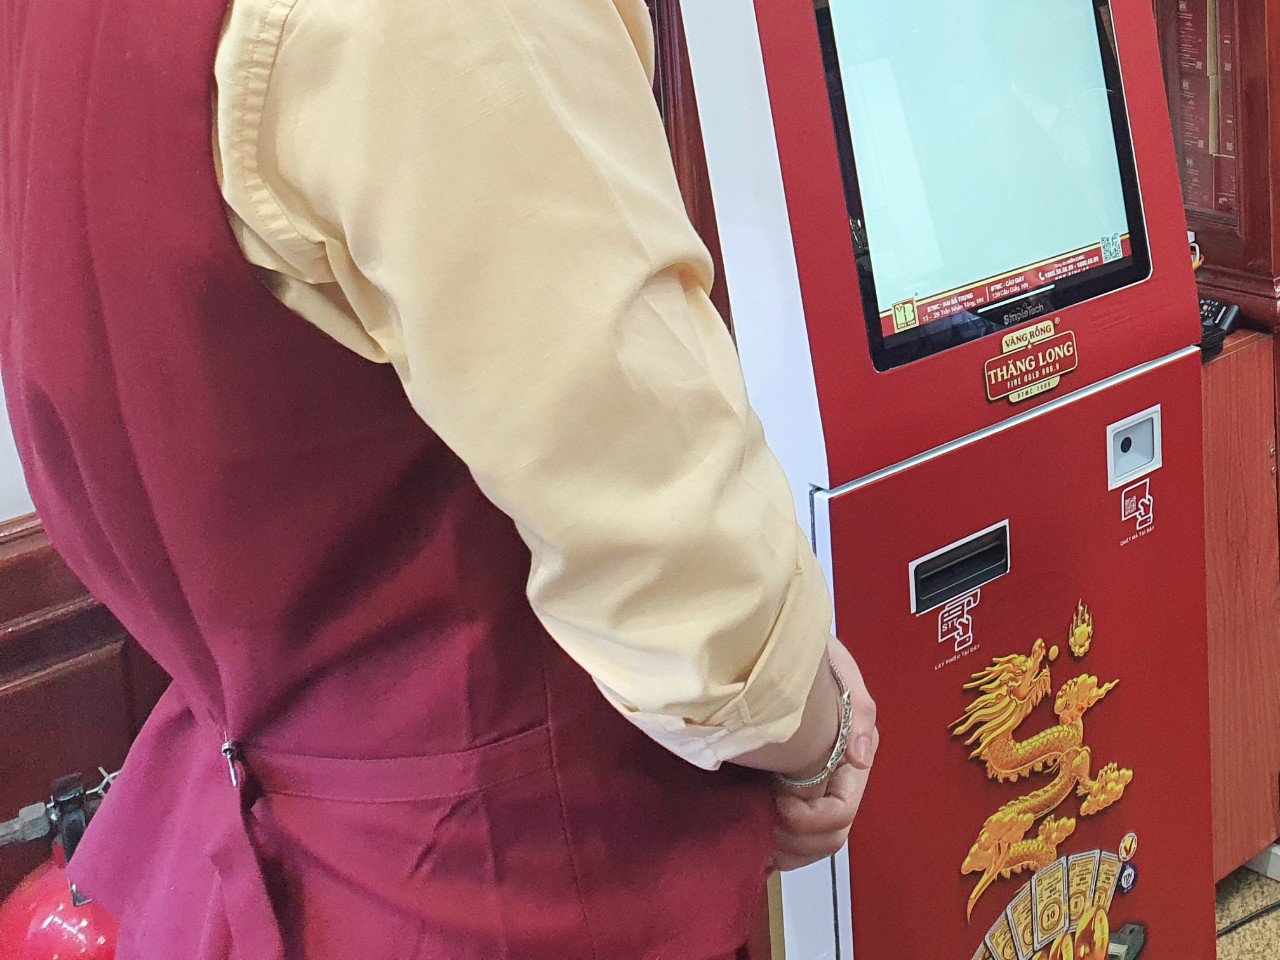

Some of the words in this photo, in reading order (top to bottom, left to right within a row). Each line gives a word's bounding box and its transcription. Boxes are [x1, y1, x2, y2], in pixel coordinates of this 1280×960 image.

[1003, 303, 1044, 325] SimpleTech
[1005, 333, 1028, 348] VÀNG
[1029, 324, 1052, 339] RỒNG
[988, 355, 1036, 385] THĂNG
[1038, 341, 1074, 366] LONG
[1007, 377, 1022, 389] FINE
[1024, 370, 1040, 383] GOLD
